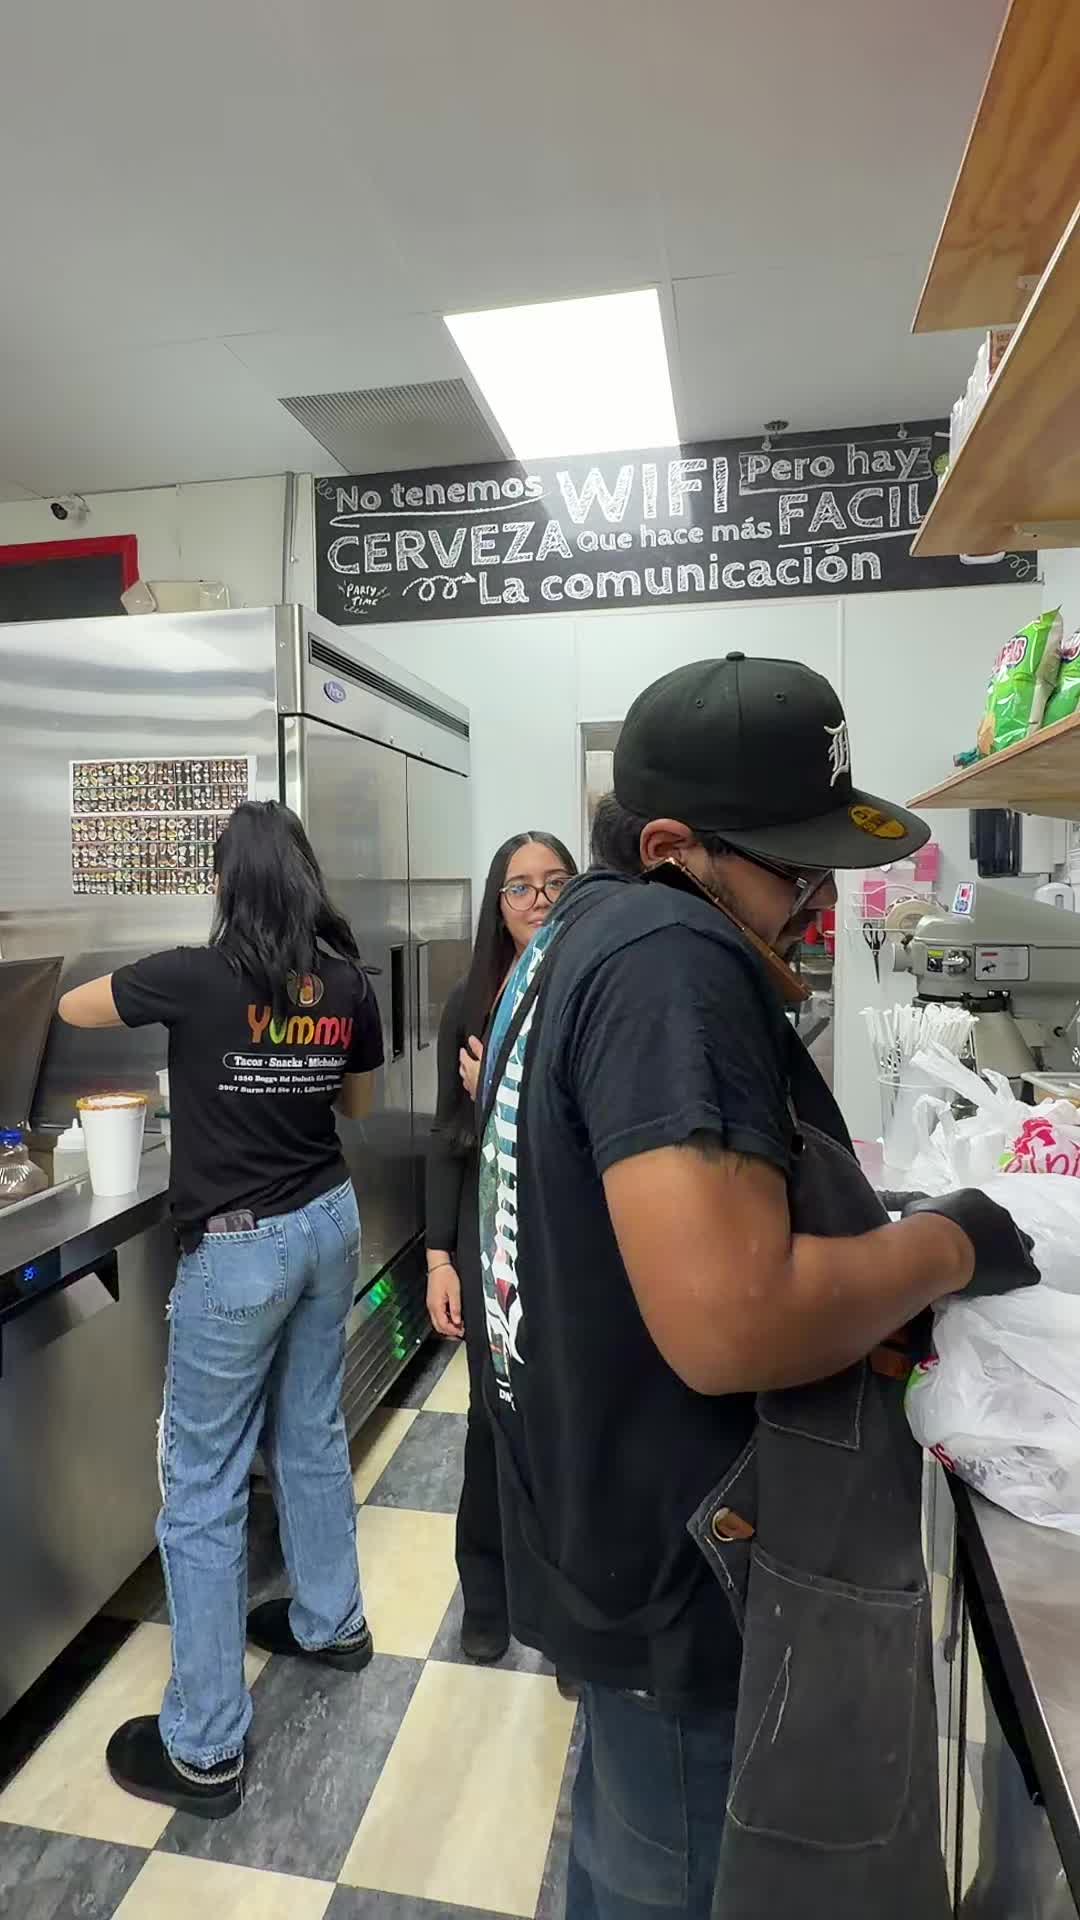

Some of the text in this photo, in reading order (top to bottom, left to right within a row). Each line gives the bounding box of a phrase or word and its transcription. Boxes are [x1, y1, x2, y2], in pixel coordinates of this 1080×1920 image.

[336, 443, 921, 523] No tenemos WIFI Pero hay
[327, 520, 573, 574] CERVEZA
[639, 524, 704, 548] hace
[712, 517, 772, 542] más
[778, 483, 928, 535] FACIL
[347, 583, 377, 598] PARTY
[479, 543, 882, 605] La comunicación
[351, 596, 379, 606] TIME
[247, 1004, 353, 1049] Yummy
[234, 1056, 263, 1067] Tacos
[268, 1057, 303, 1068] Snacks
